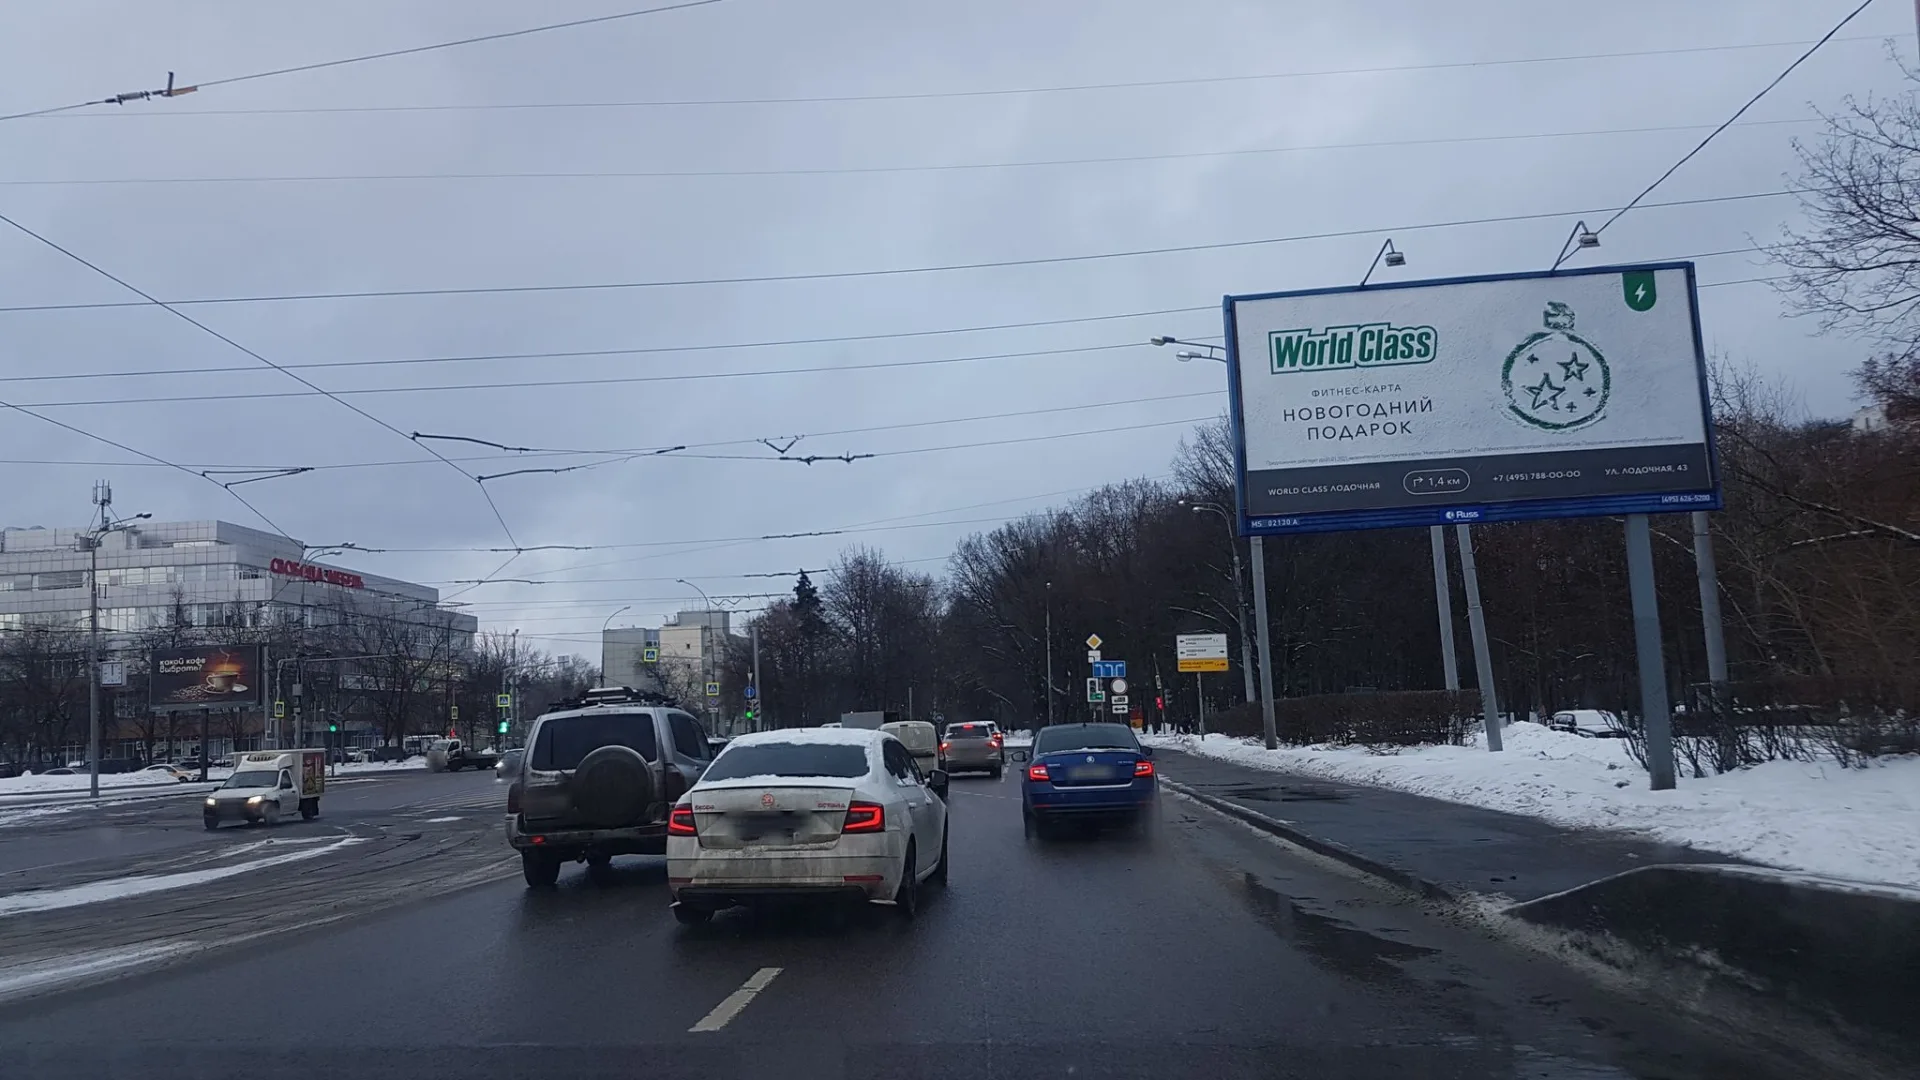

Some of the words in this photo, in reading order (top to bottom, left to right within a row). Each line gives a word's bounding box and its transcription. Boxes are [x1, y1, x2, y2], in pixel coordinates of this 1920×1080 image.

[1275, 331, 1353, 369] World
[1358, 329, 1431, 363] Class
[1311, 384, 1402, 398] ФИТНЕС-КАРТА
[1283, 396, 1433, 422] НОВОГОДНИЙ
[1307, 421, 1412, 441] ПОДАРОК
[1492, 474, 1503, 482] +7
[1505, 472, 1528, 482] (495)
[1605, 467, 1619, 476] УЛ.
[1622, 464, 1675, 475] ЛОДОЧНАЯ,
[1676, 464, 1688, 472] 43
[1268, 487, 1300, 496] WORLD
[1301, 485, 1328, 494] CLASS
[1330, 482, 1380, 493] ЛОДОЧНАЯ
[1428, 476, 1444, 488] 1,4
[1456, 510, 1479, 519] Russ
